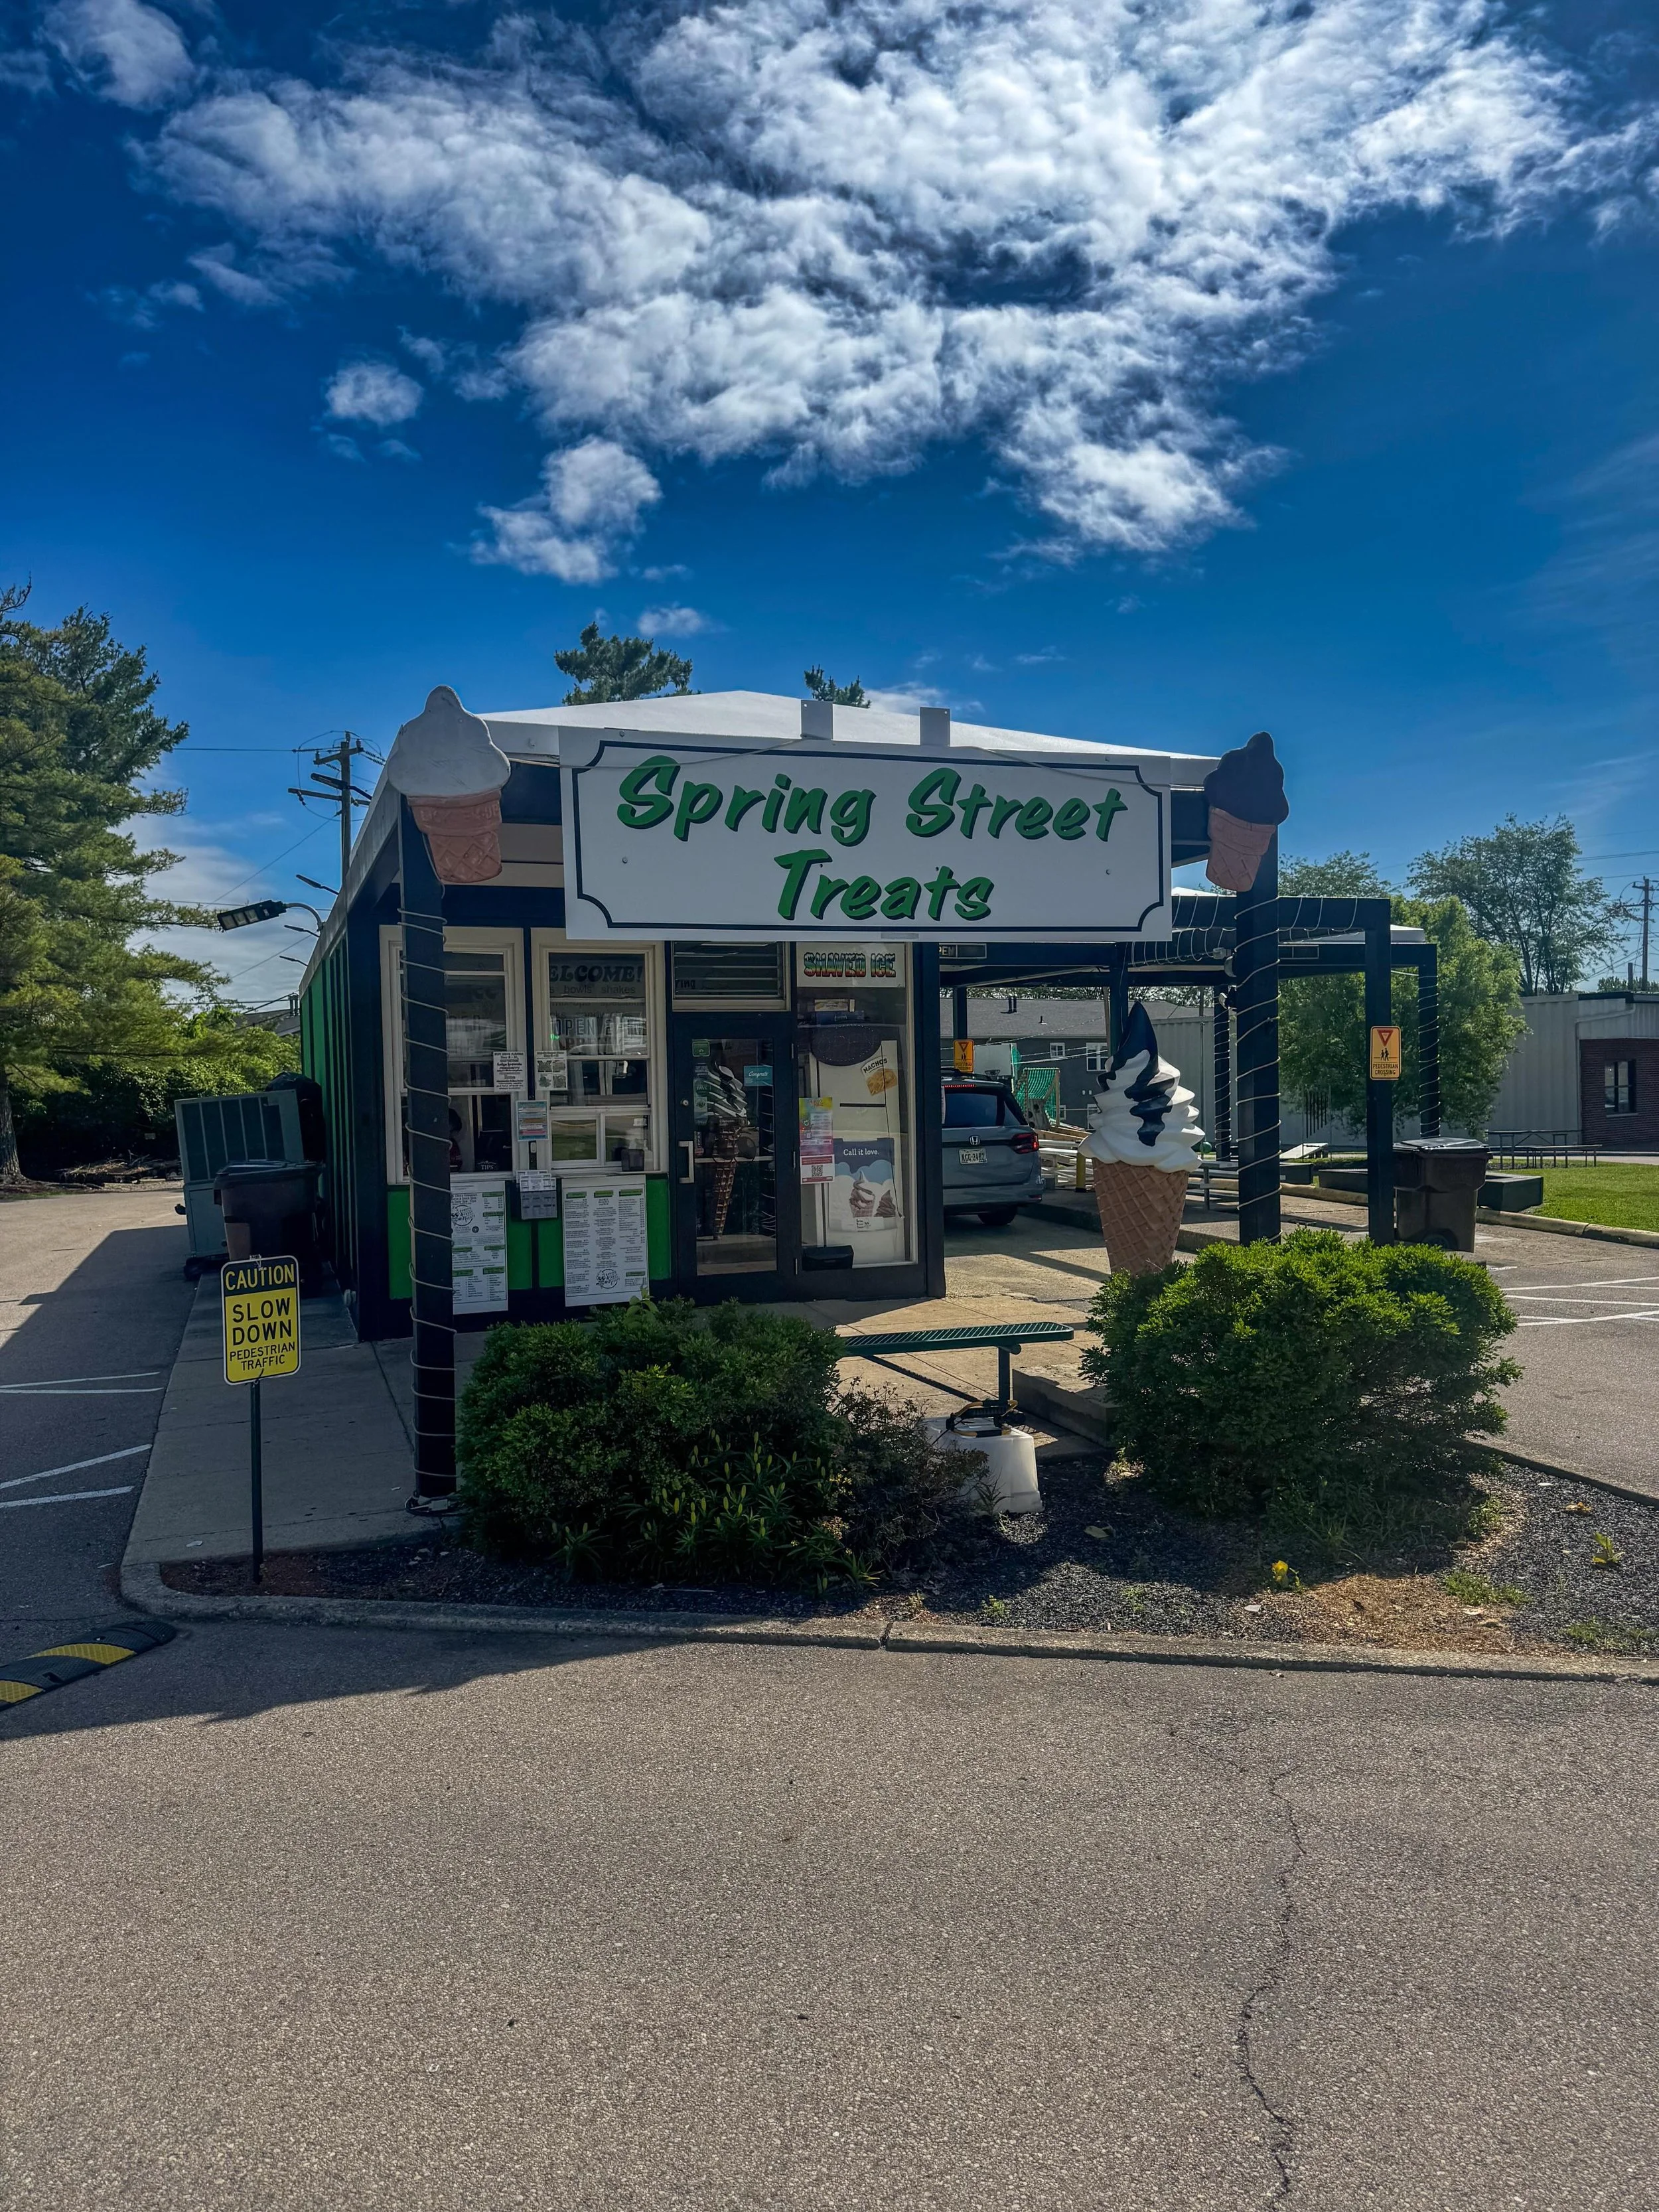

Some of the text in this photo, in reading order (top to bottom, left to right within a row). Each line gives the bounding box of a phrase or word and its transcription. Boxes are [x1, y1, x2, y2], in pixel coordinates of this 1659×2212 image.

[618, 755, 1127, 846] Spring Street
[774, 848, 994, 920] Treats
[804, 952, 896, 978] SHAVED ICE
[565, 984, 592, 994] bowls
[601, 985, 636, 994] shakes
[863, 1058, 888, 1073] NACHOS
[225, 1264, 295, 1290] CAUTION
[232, 1297, 291, 1323] SLOW
[233, 1319, 291, 1346] DOWN
[230, 1341, 295, 1361] PEDESTRIAN
[241, 1355, 285, 1371] TRAFFIC
